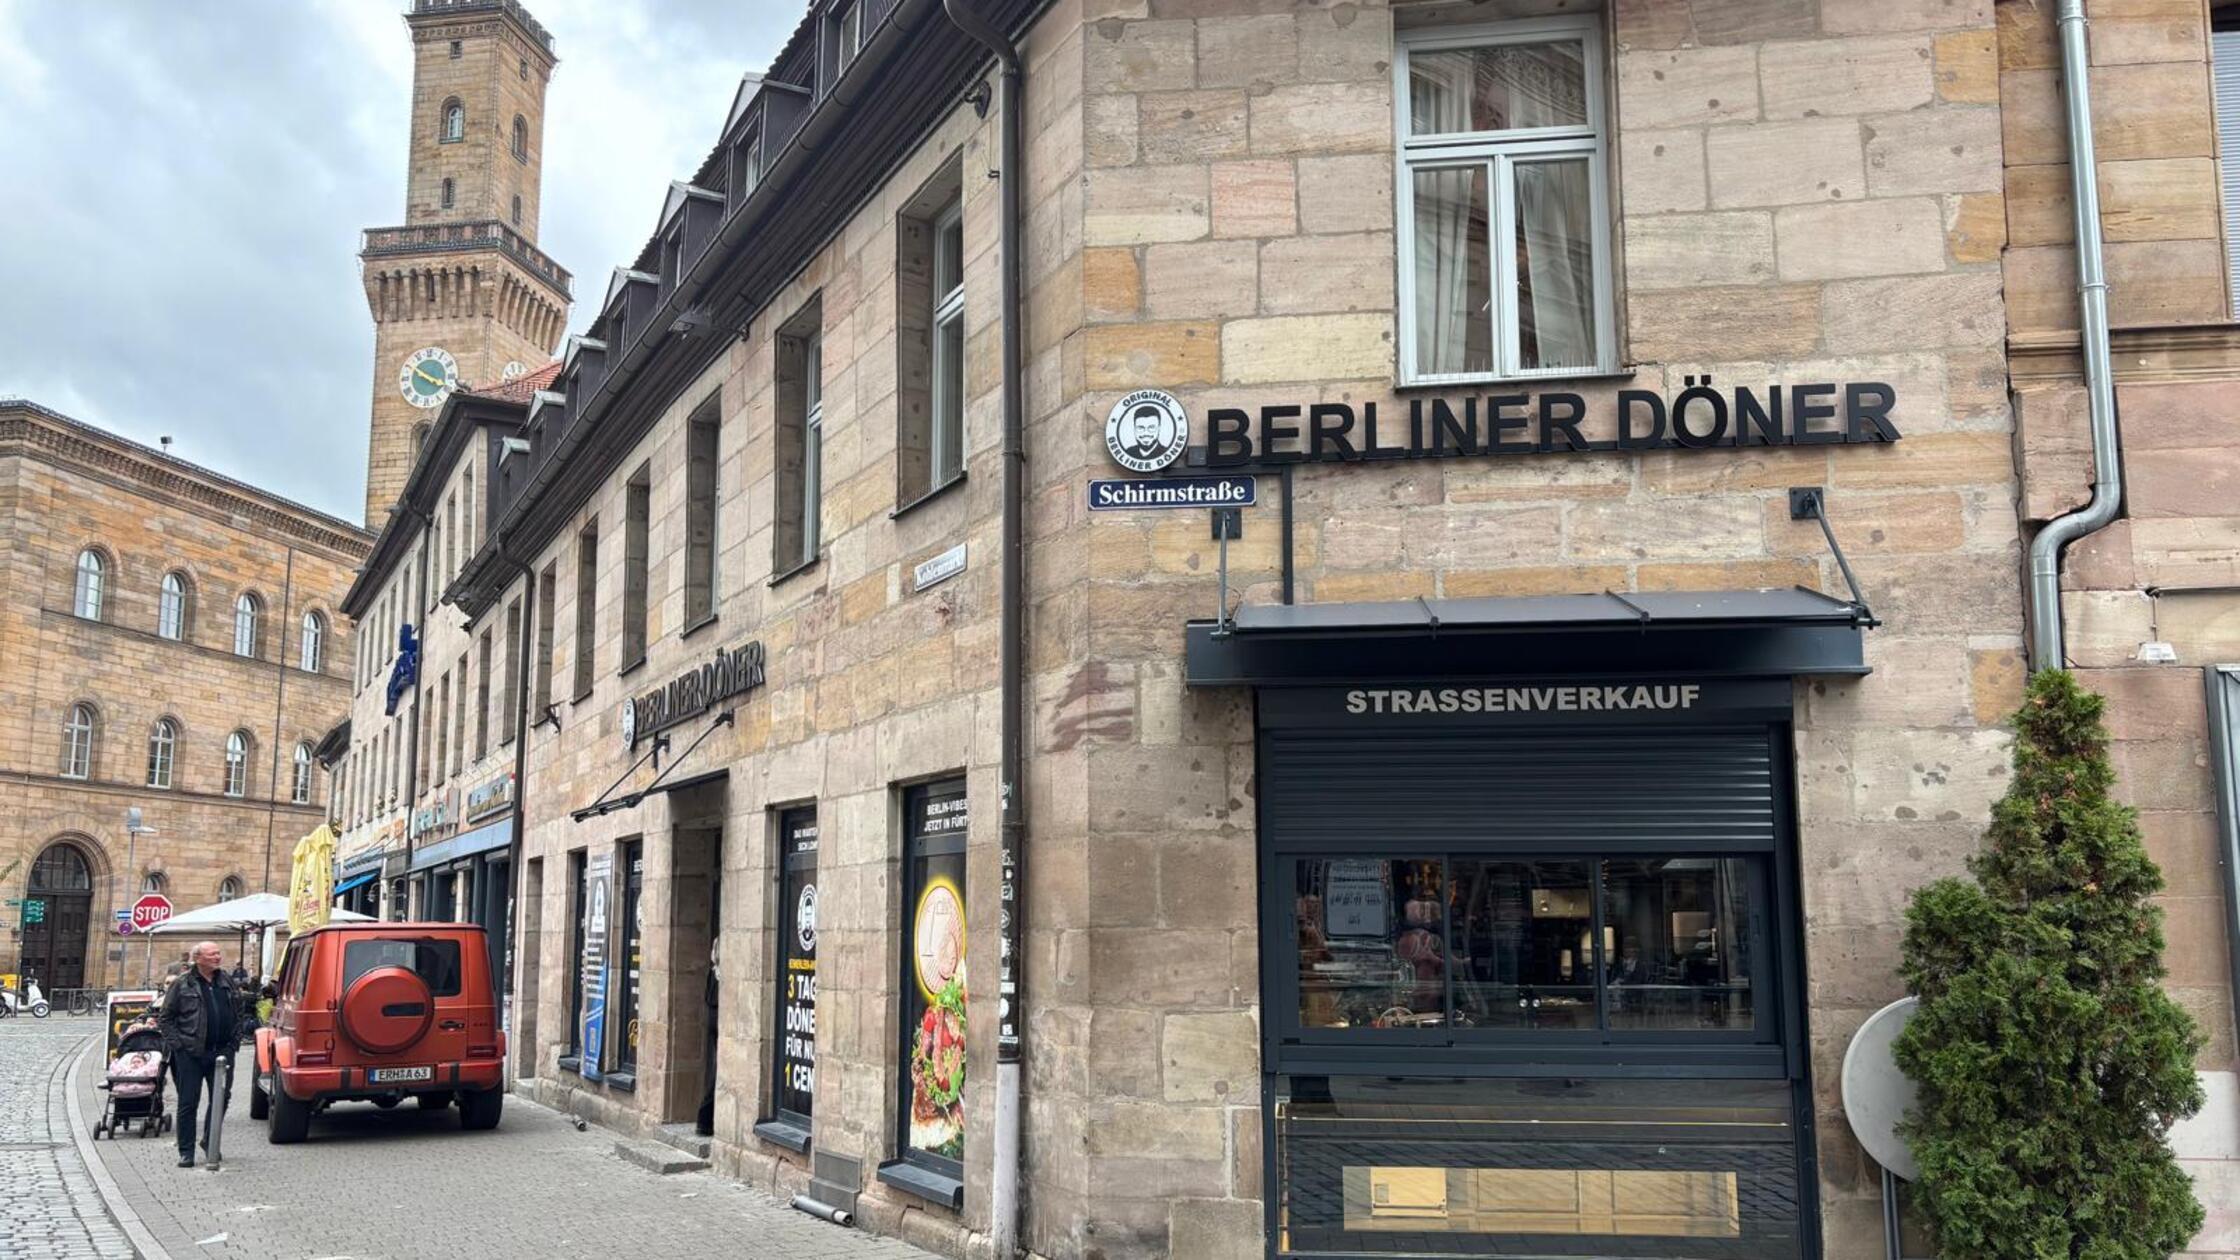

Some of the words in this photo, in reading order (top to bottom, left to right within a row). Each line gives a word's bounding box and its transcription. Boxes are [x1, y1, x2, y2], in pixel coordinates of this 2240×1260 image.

[1122, 391, 1172, 408] ORIGINAL
[1207, 392, 1590, 466] BERLINER
[1617, 374, 1903, 449] DÖNER
[1108, 436, 1152, 470] BERLINER
[1156, 435, 1186, 467] DÖNER
[1099, 481, 1245, 505] Schirmstraße
[636, 669, 705, 732] BERLINER
[701, 640, 765, 704] DÖNER
[1346, 684, 1700, 713] STRASSENVERKAUF
[924, 818, 943, 833] JETZT
[943, 818, 950, 829] IN
[951, 814, 968, 828] FÜRT
[135, 906, 169, 921] STOP
[787, 974, 795, 999] 3
[796, 975, 816, 1000] TAG
[786, 1002, 816, 1033] DÖNE
[785, 1034, 802, 1058] FÜR
[803, 1041, 815, 1062] NU
[379, 1070, 400, 1081] ERH
[406, 1070, 413, 1080] A
[414, 1068, 427, 1078] 63
[784, 1062, 791, 1087] 1
[793, 1064, 814, 1093] CEN
